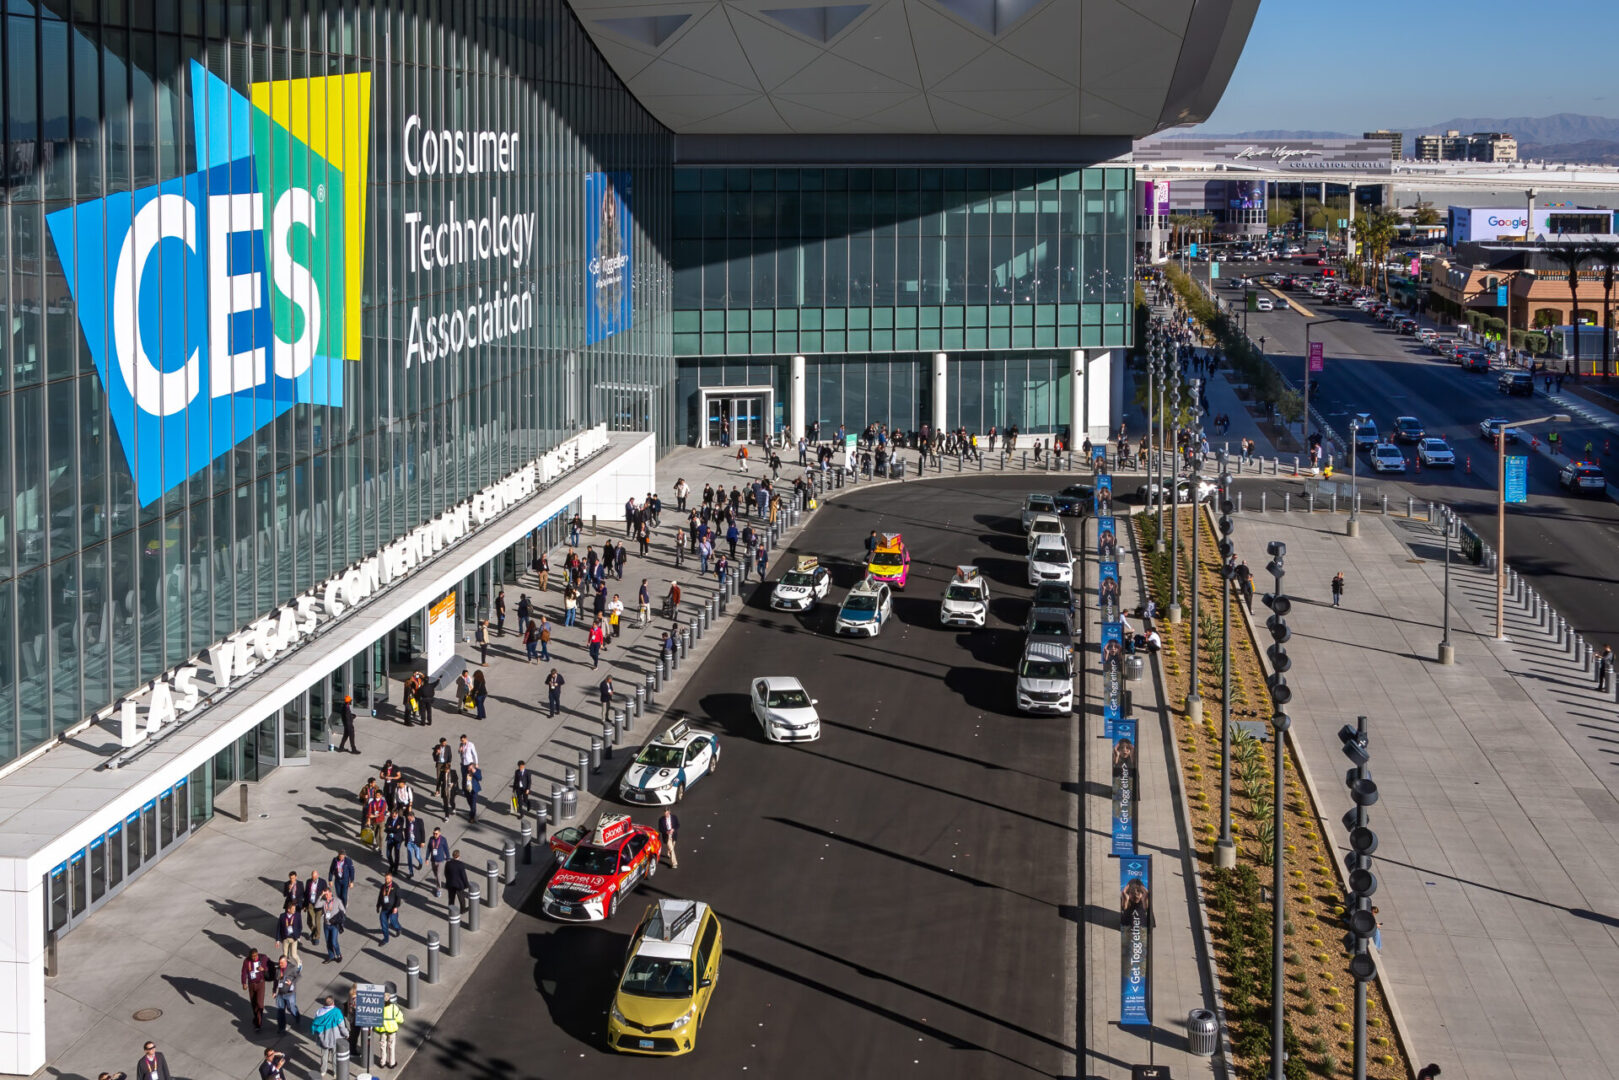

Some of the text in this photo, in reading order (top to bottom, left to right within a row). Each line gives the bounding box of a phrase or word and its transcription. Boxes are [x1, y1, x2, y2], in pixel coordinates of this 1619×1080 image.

[404, 114, 519, 177] Consumer
[1270, 145, 1322, 164] Vegas
[1488, 215, 1528, 229] Google
[404, 196, 535, 274] Technology
[113, 187, 321, 417] CES
[406, 281, 533, 369] Association
[779, 585, 806, 594] 7930
[121, 665, 199, 748] LAS
[208, 597, 317, 689] VEGAS
[324, 500, 470, 617] CONVENTION
[1120, 809, 1129, 824] Get
[555, 873, 590, 883] planet
[1131, 966, 1141, 984] Get
[357, 1006, 383, 1014] STAND
